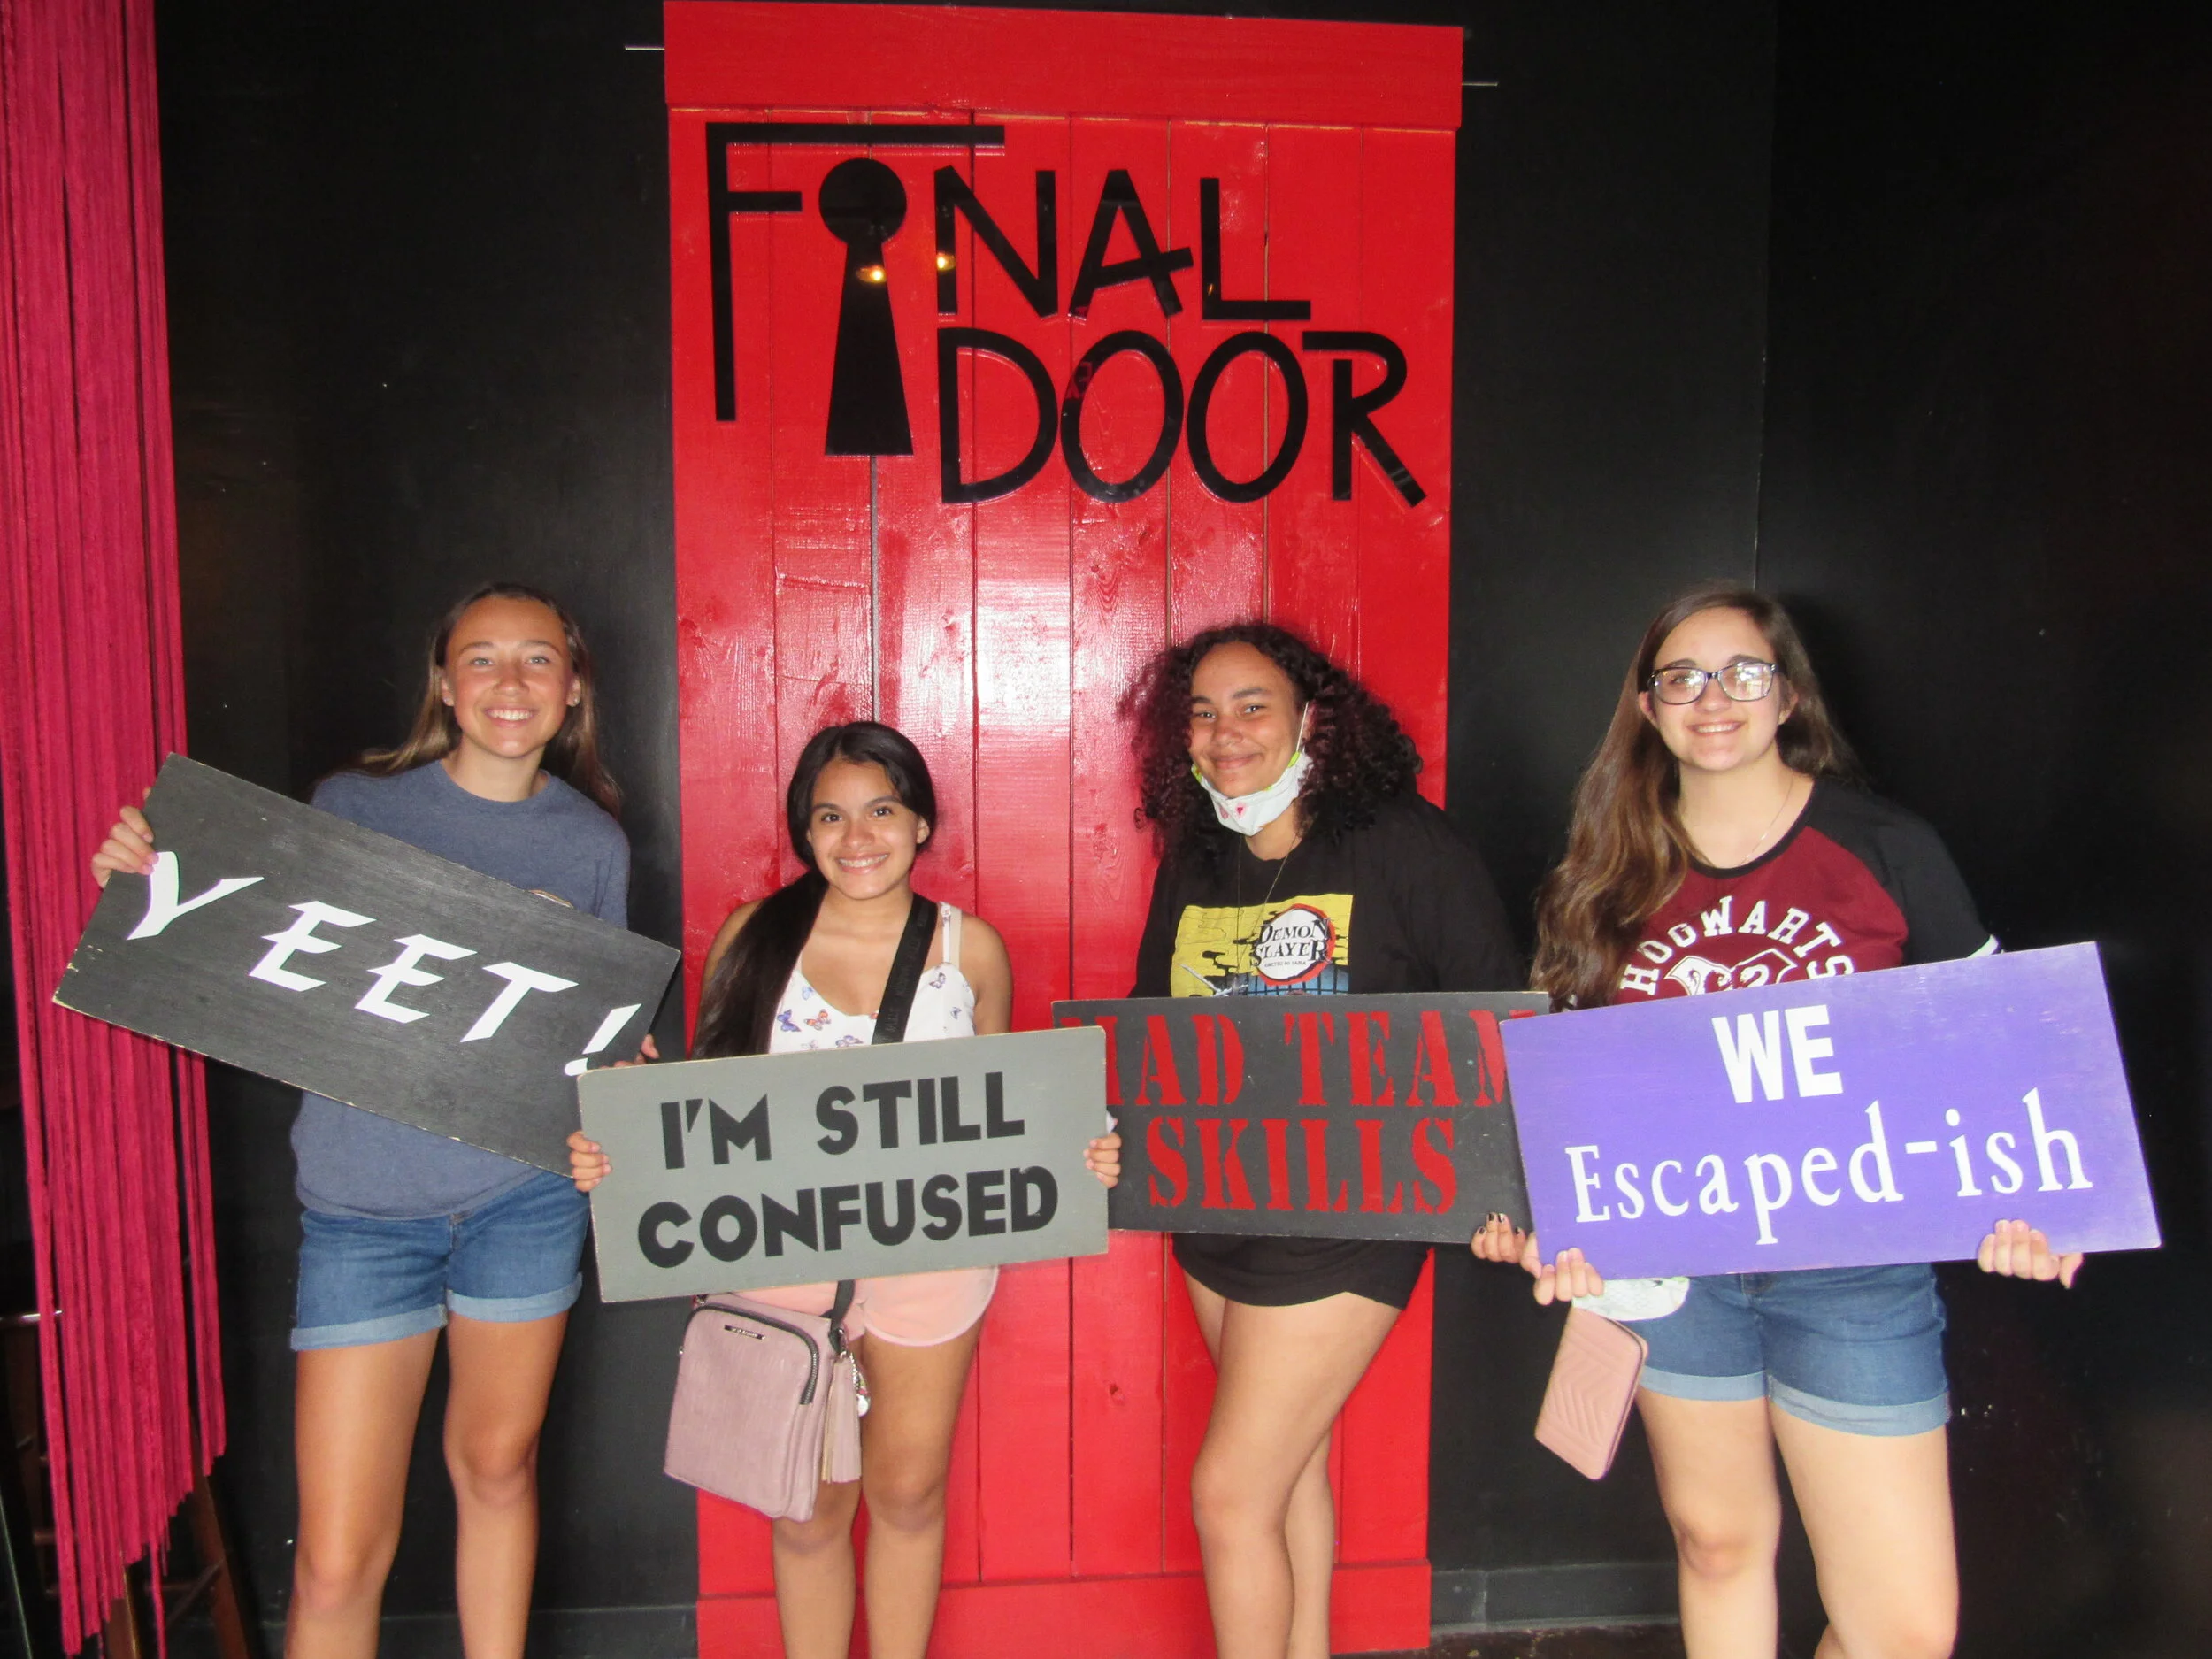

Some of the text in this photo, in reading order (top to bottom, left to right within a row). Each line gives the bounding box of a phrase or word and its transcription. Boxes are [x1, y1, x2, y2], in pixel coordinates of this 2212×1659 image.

[706, 123, 1311, 457] FINAL
[936, 327, 1427, 510] DOOR
[127, 850, 641, 1077] YEET!
[1248, 939, 1331, 967] SLAYER
[1259, 918, 1333, 945] DEMON
[1711, 1003, 1845, 1105] WE
[660, 1071, 1025, 1171] I'M STILL
[1146, 1116, 1458, 1216] SKILLS
[1565, 1087, 2093, 1246] Escaped-ish
[637, 1165, 1059, 1269] CONFUSED
